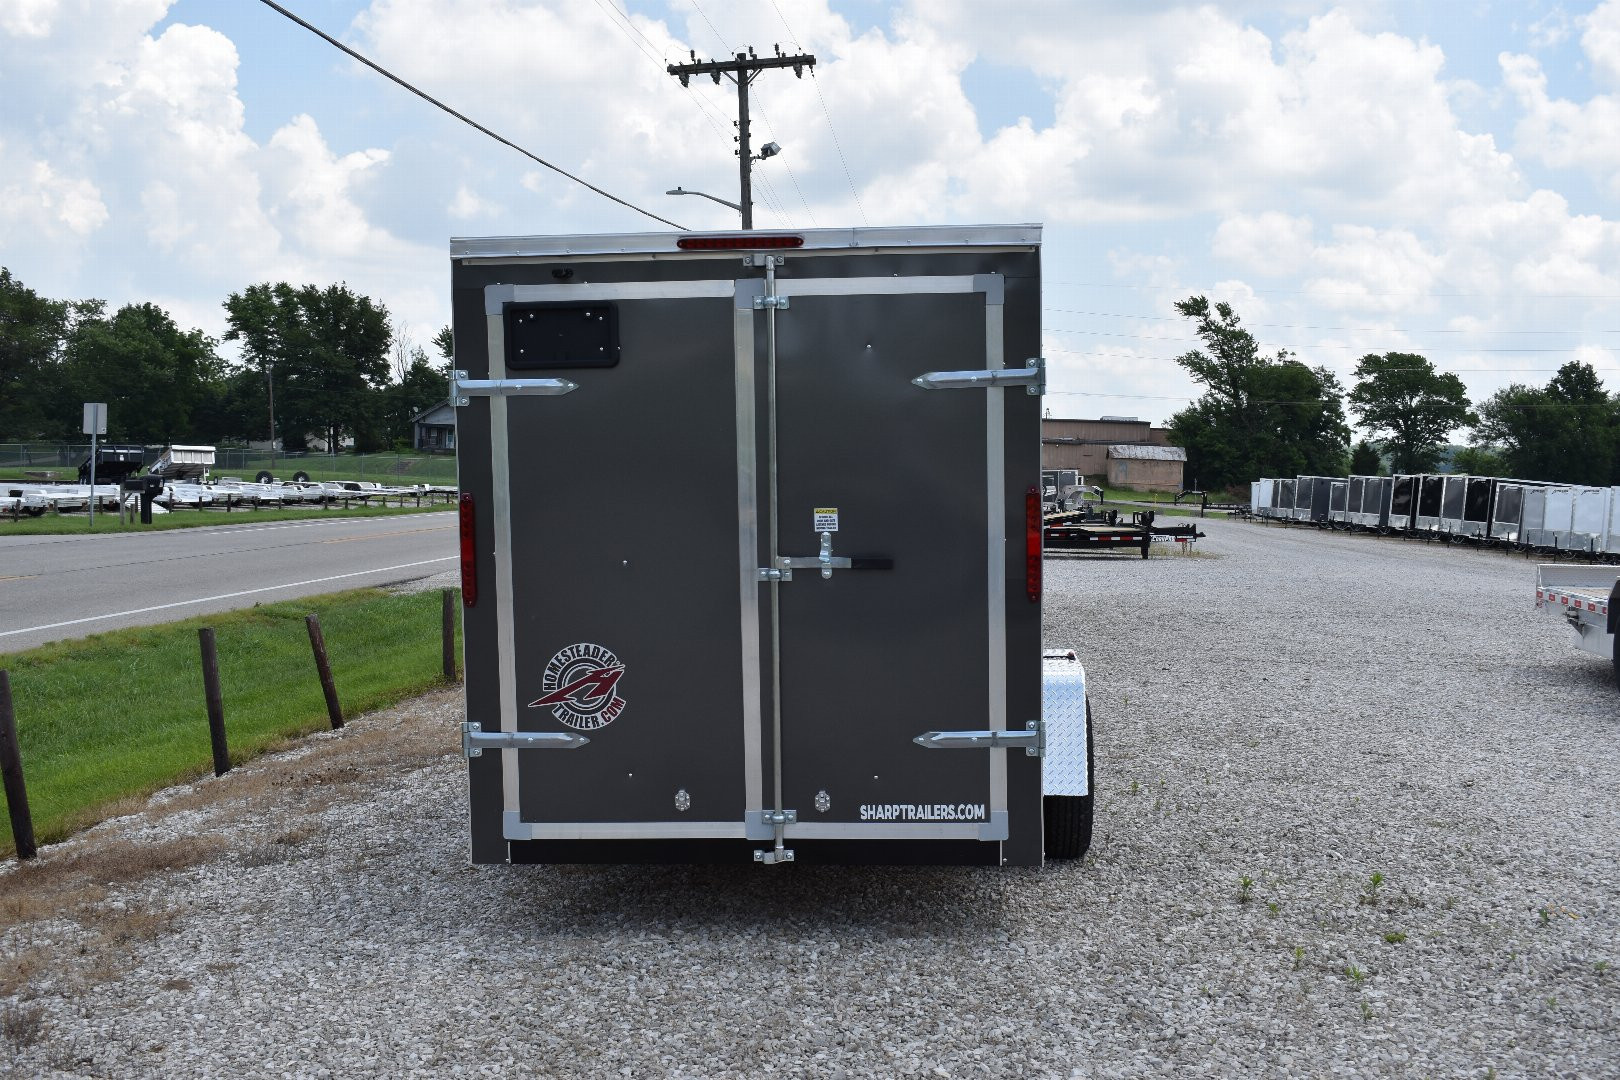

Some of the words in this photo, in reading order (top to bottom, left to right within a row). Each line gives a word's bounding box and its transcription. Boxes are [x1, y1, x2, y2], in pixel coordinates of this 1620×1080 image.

[544, 644, 616, 691] HOMESTEADER
[552, 697, 625, 729] TRAILER.COM
[860, 804, 985, 820] SHARPTRAILERS.COM
